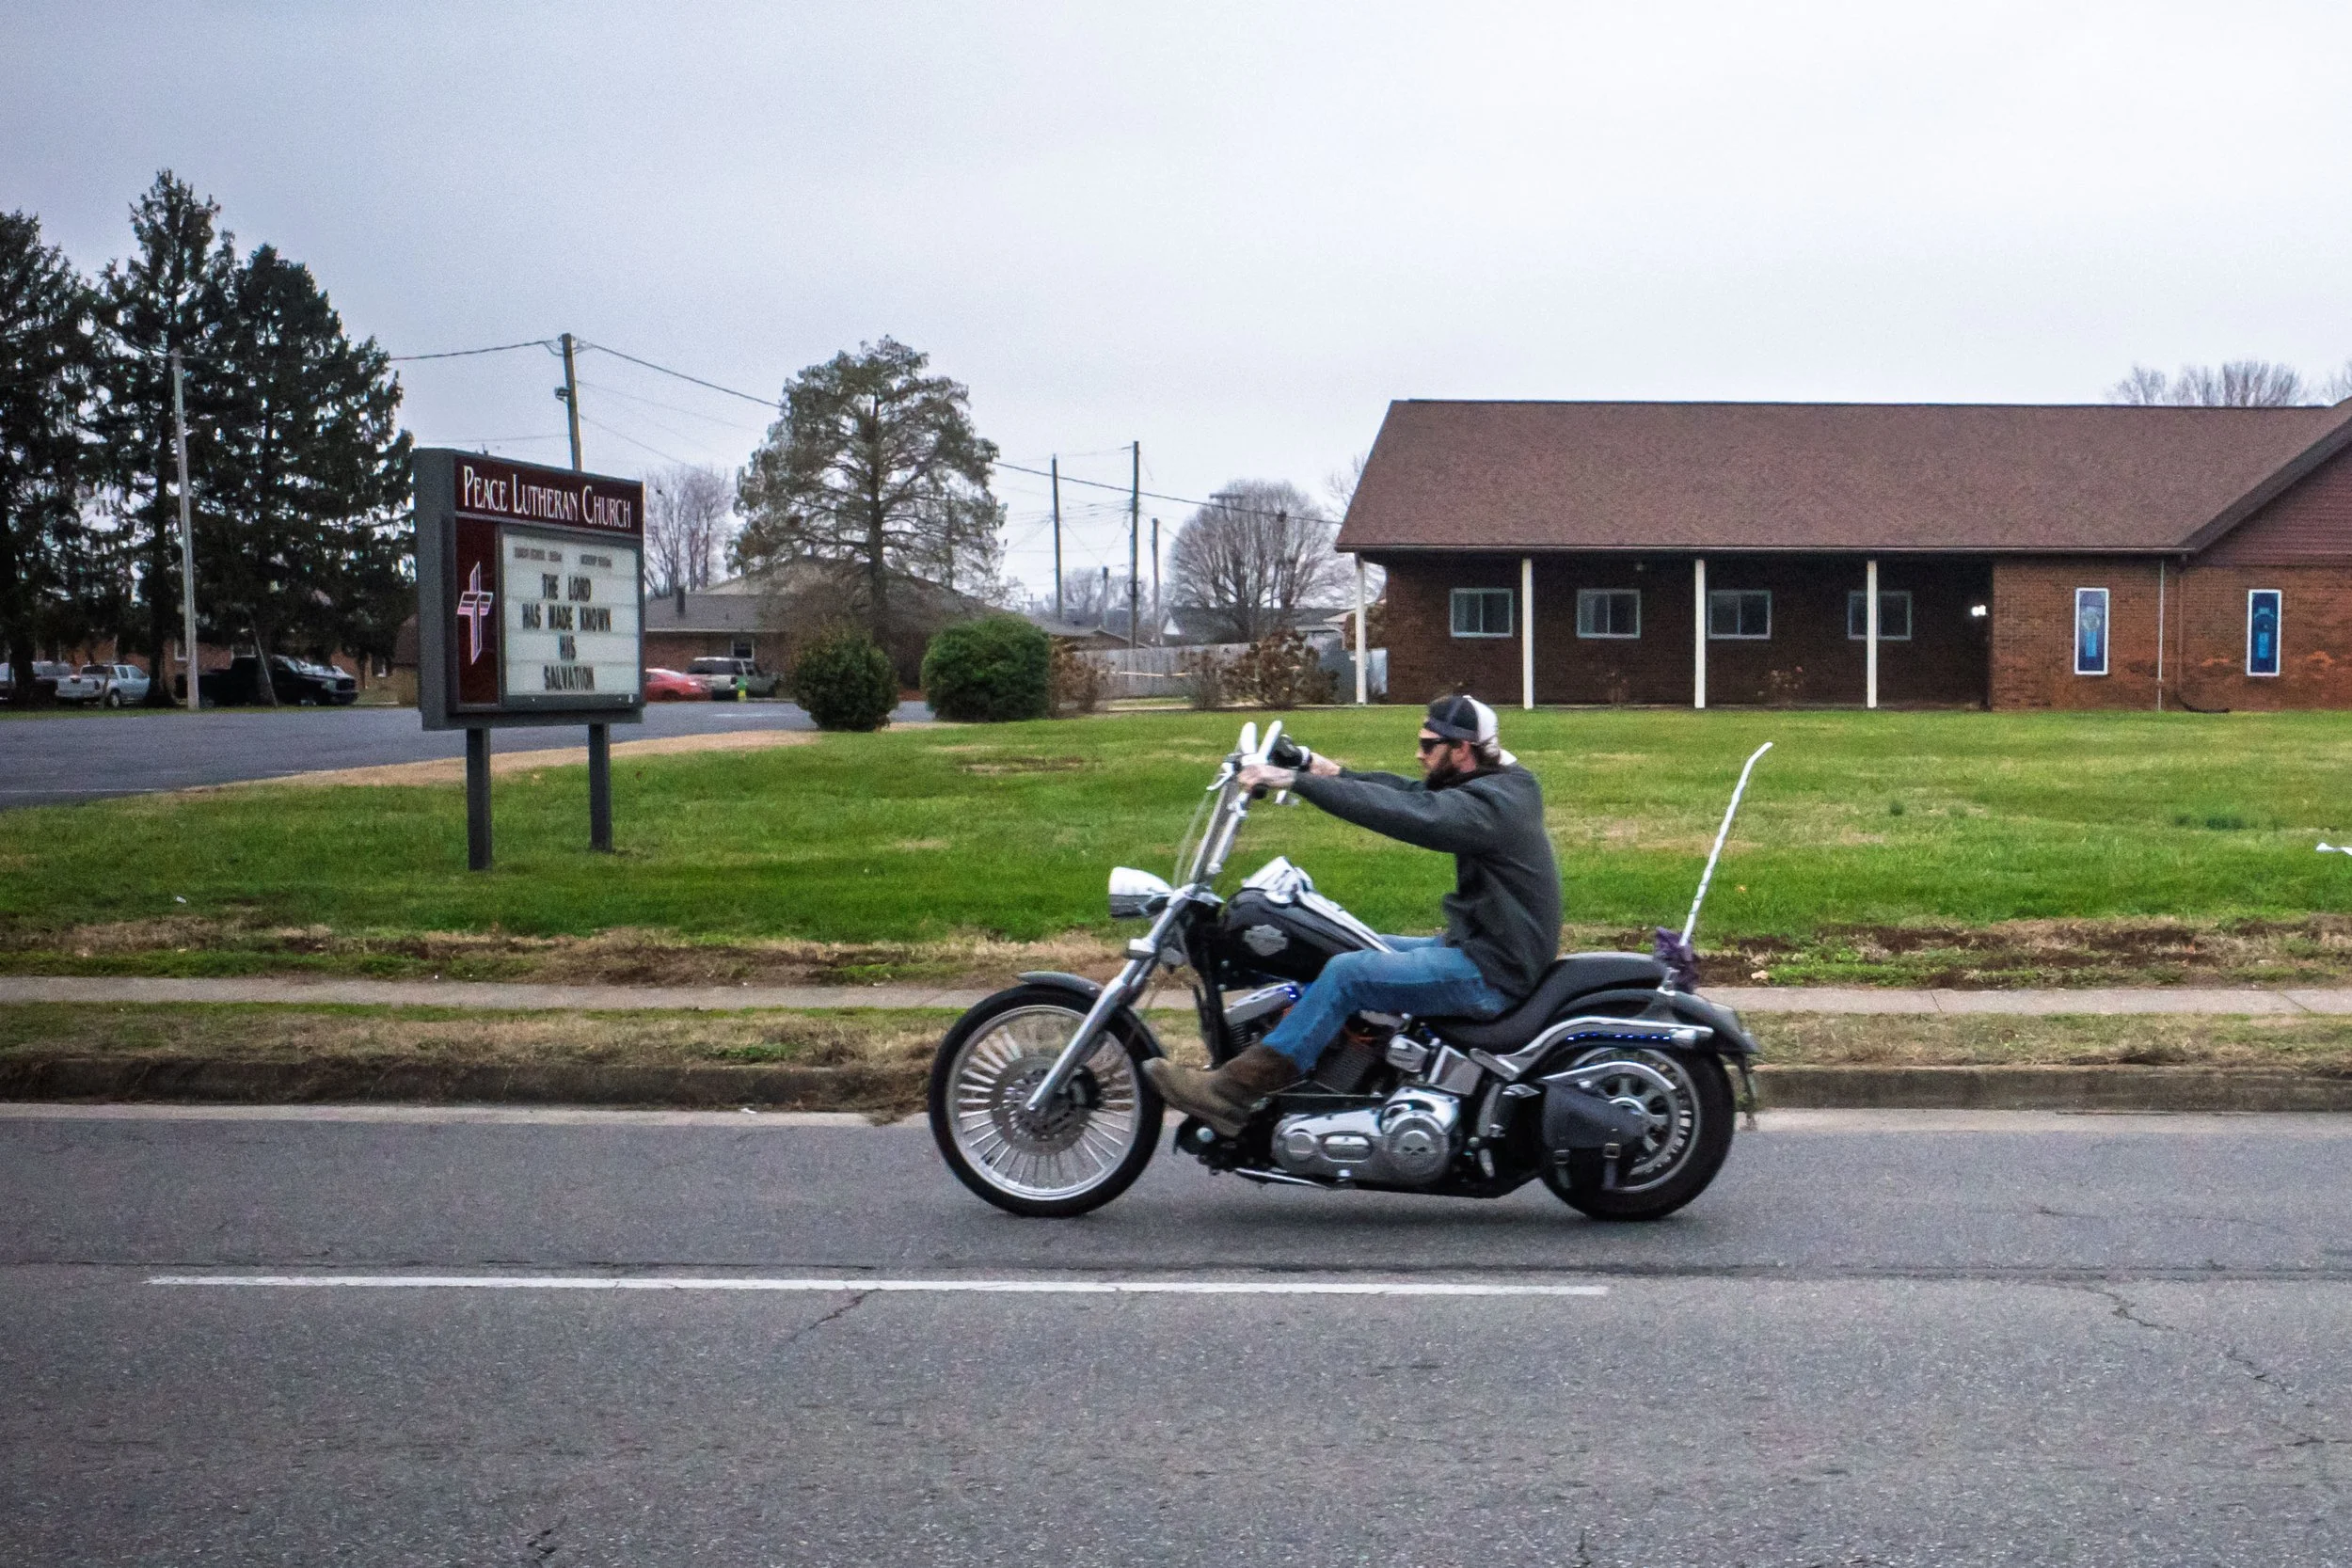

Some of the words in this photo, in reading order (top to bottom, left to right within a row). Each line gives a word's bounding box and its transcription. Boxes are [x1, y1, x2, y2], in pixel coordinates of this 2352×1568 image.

[463, 465, 508, 512] PEACE
[513, 474, 579, 521] LUTHERAN
[582, 484, 631, 529] CHURCH
[542, 573, 559, 599] THE
[567, 574, 592, 602] LORD
[522, 603, 542, 630] HAS
[548, 604, 573, 631] MADE
[580, 606, 612, 633] KNOWN
[559, 634, 577, 660] HIS
[544, 664, 595, 691] SALVATION
